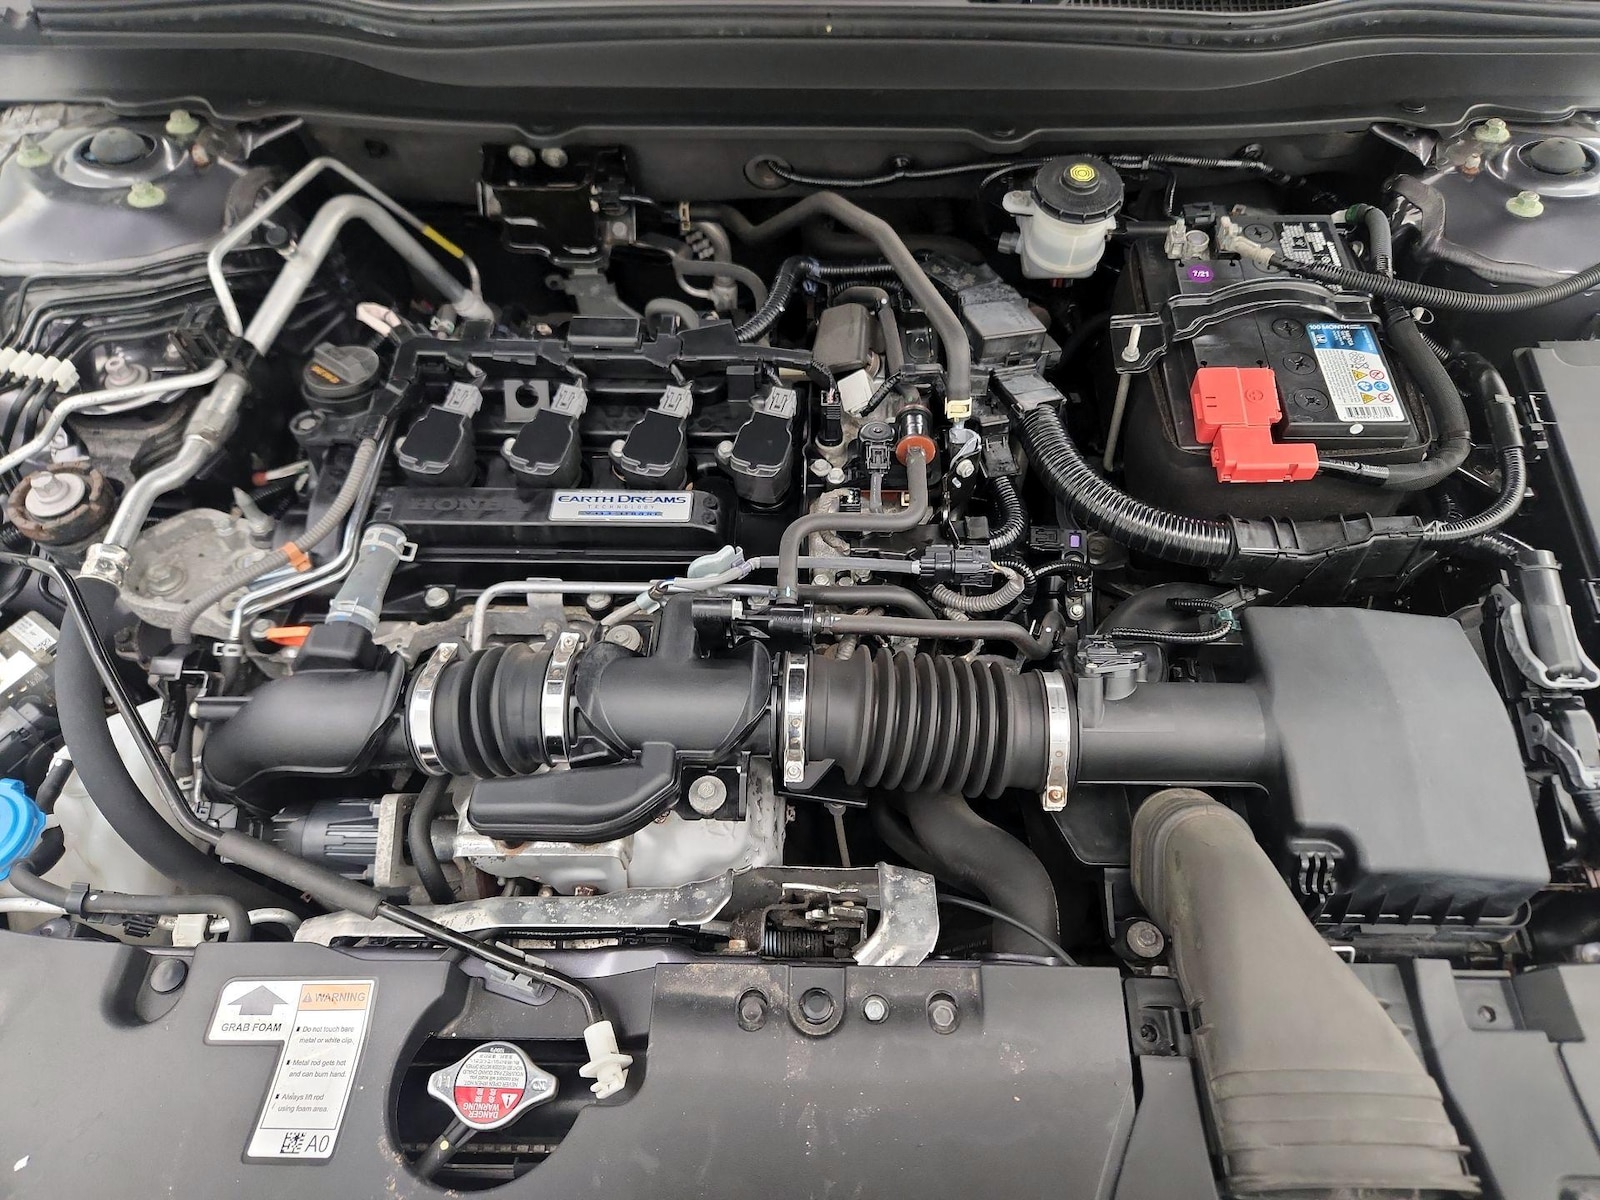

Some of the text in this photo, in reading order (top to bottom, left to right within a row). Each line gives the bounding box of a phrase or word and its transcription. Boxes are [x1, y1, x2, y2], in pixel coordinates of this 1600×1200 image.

[558, 495, 687, 504] EARTH DREAMS
[315, 992, 366, 1002] WARNING
[221, 1022, 282, 1032] GRAB FOAM
[321, 1060, 335, 1068] gets
[281, 1093, 303, 1101] Always
[463, 1102, 499, 1111] WARNUNG
[468, 1110, 499, 1118] DANGER
